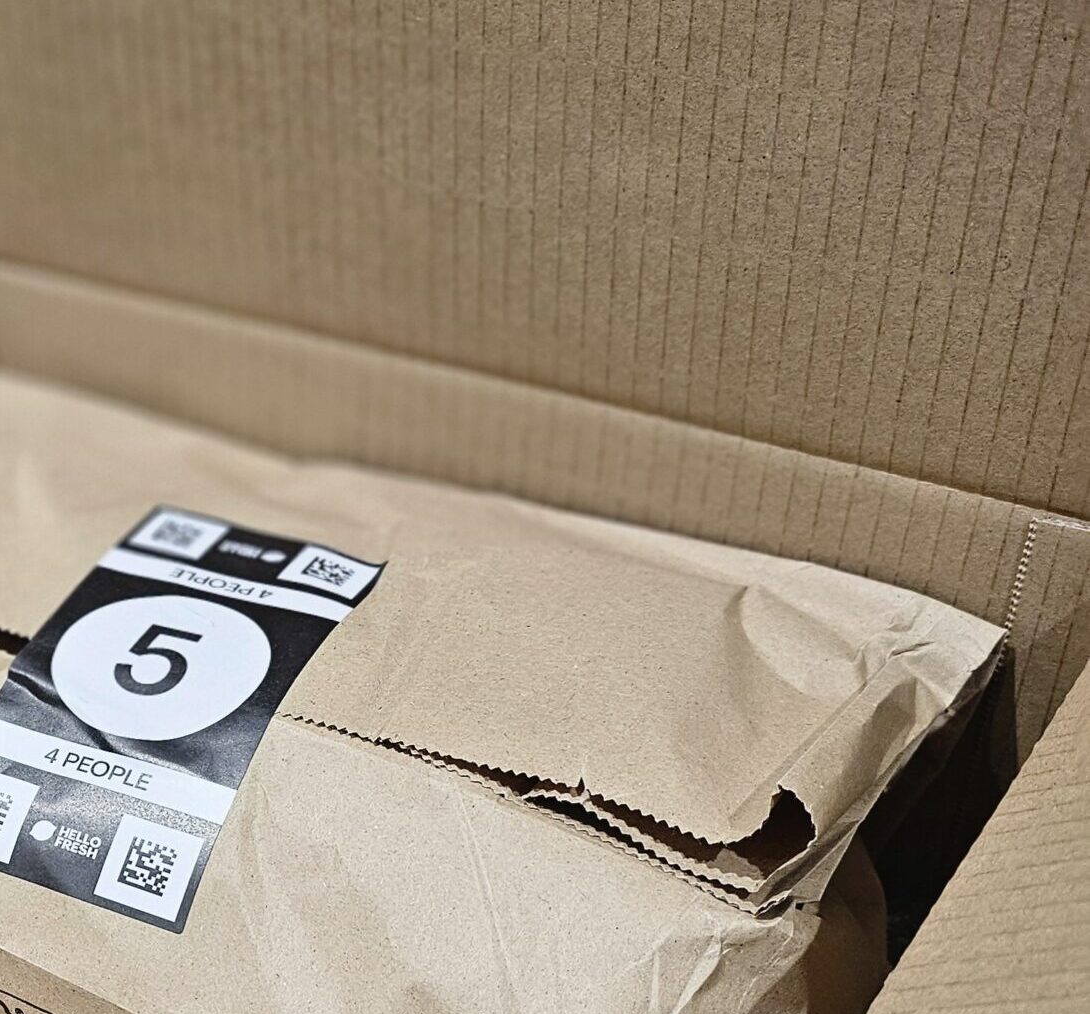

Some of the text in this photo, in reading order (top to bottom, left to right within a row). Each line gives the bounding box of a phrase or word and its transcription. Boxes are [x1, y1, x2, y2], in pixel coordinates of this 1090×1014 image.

[169, 567, 273, 599] 4 PEOPLE
[113, 623, 203, 696] 5
[44, 748, 153, 791] 4 PEOPLE
[54, 836, 99, 860] FRESH
[58, 825, 102, 849] HELLO
